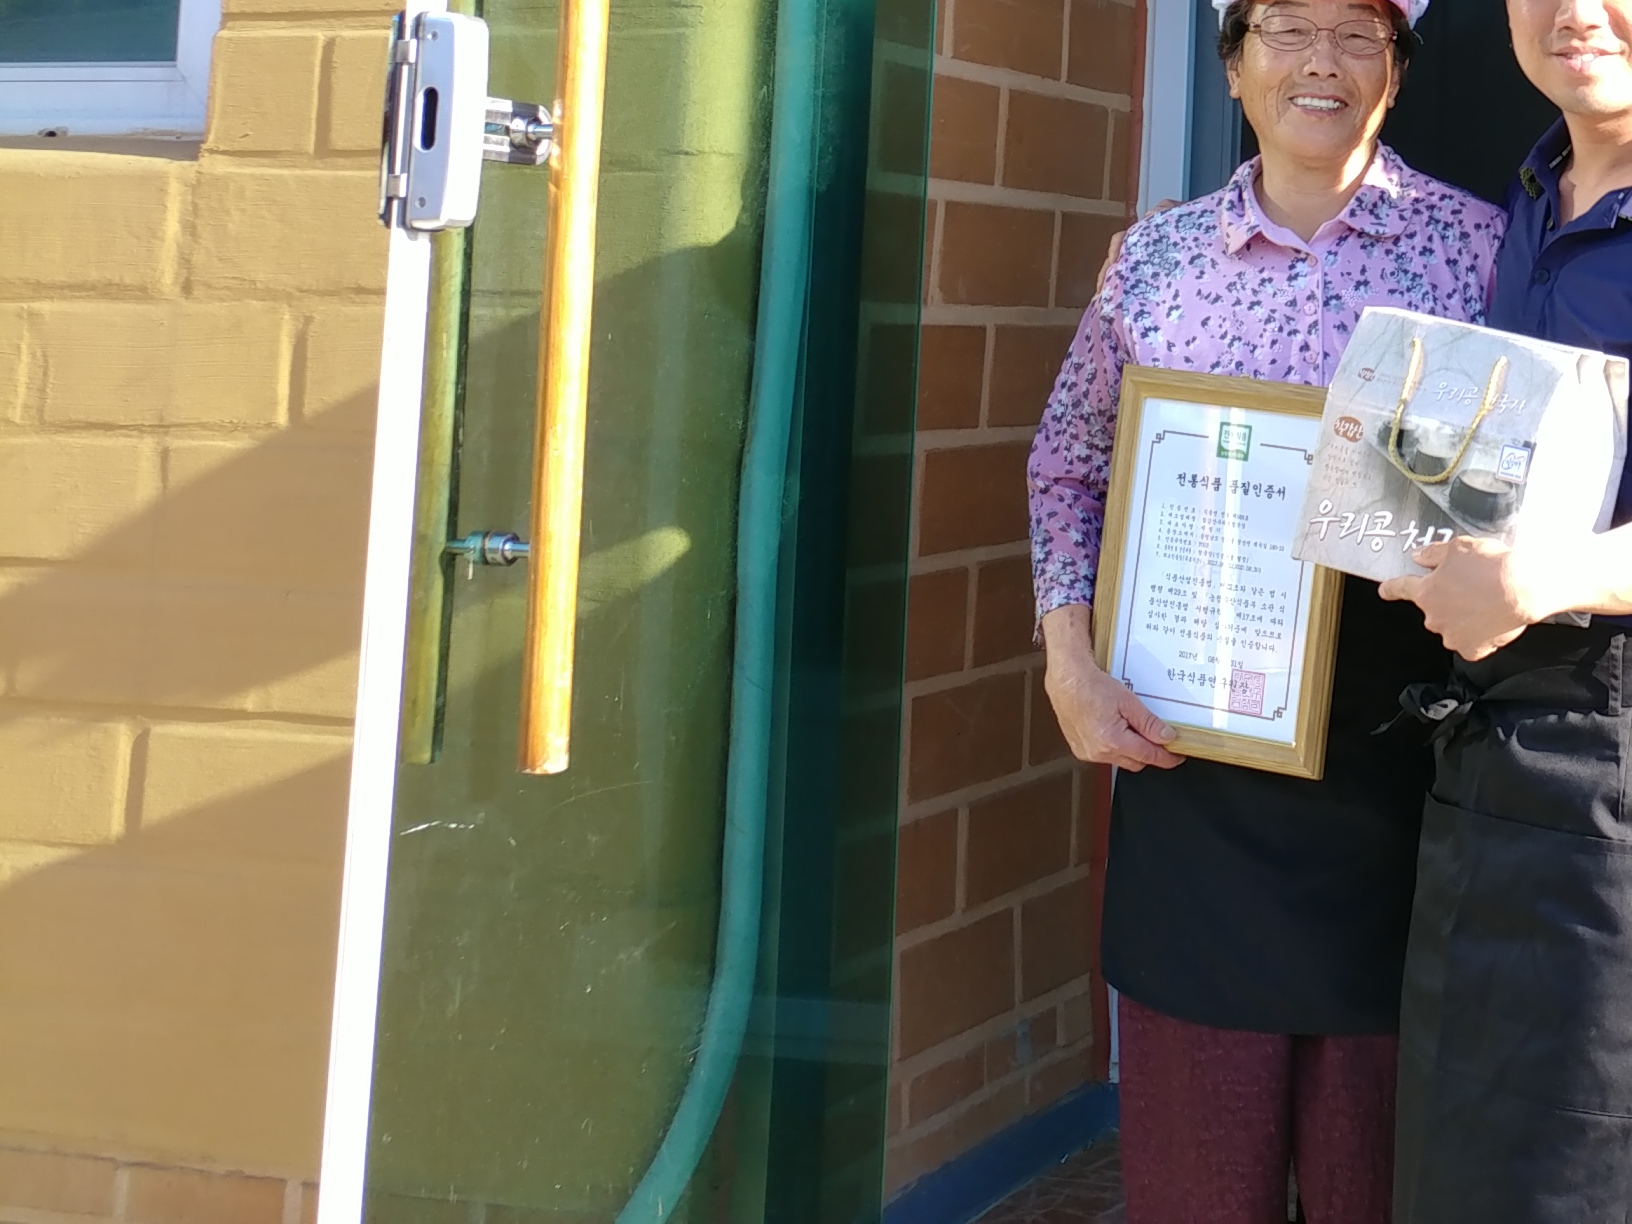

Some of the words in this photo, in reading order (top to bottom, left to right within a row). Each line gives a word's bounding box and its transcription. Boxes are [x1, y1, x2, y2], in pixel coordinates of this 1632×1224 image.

[1176, 471, 1223, 492] 전통식품
[1229, 479, 1287, 501] 품질인증서
[1310, 498, 1396, 552] 우리콩
